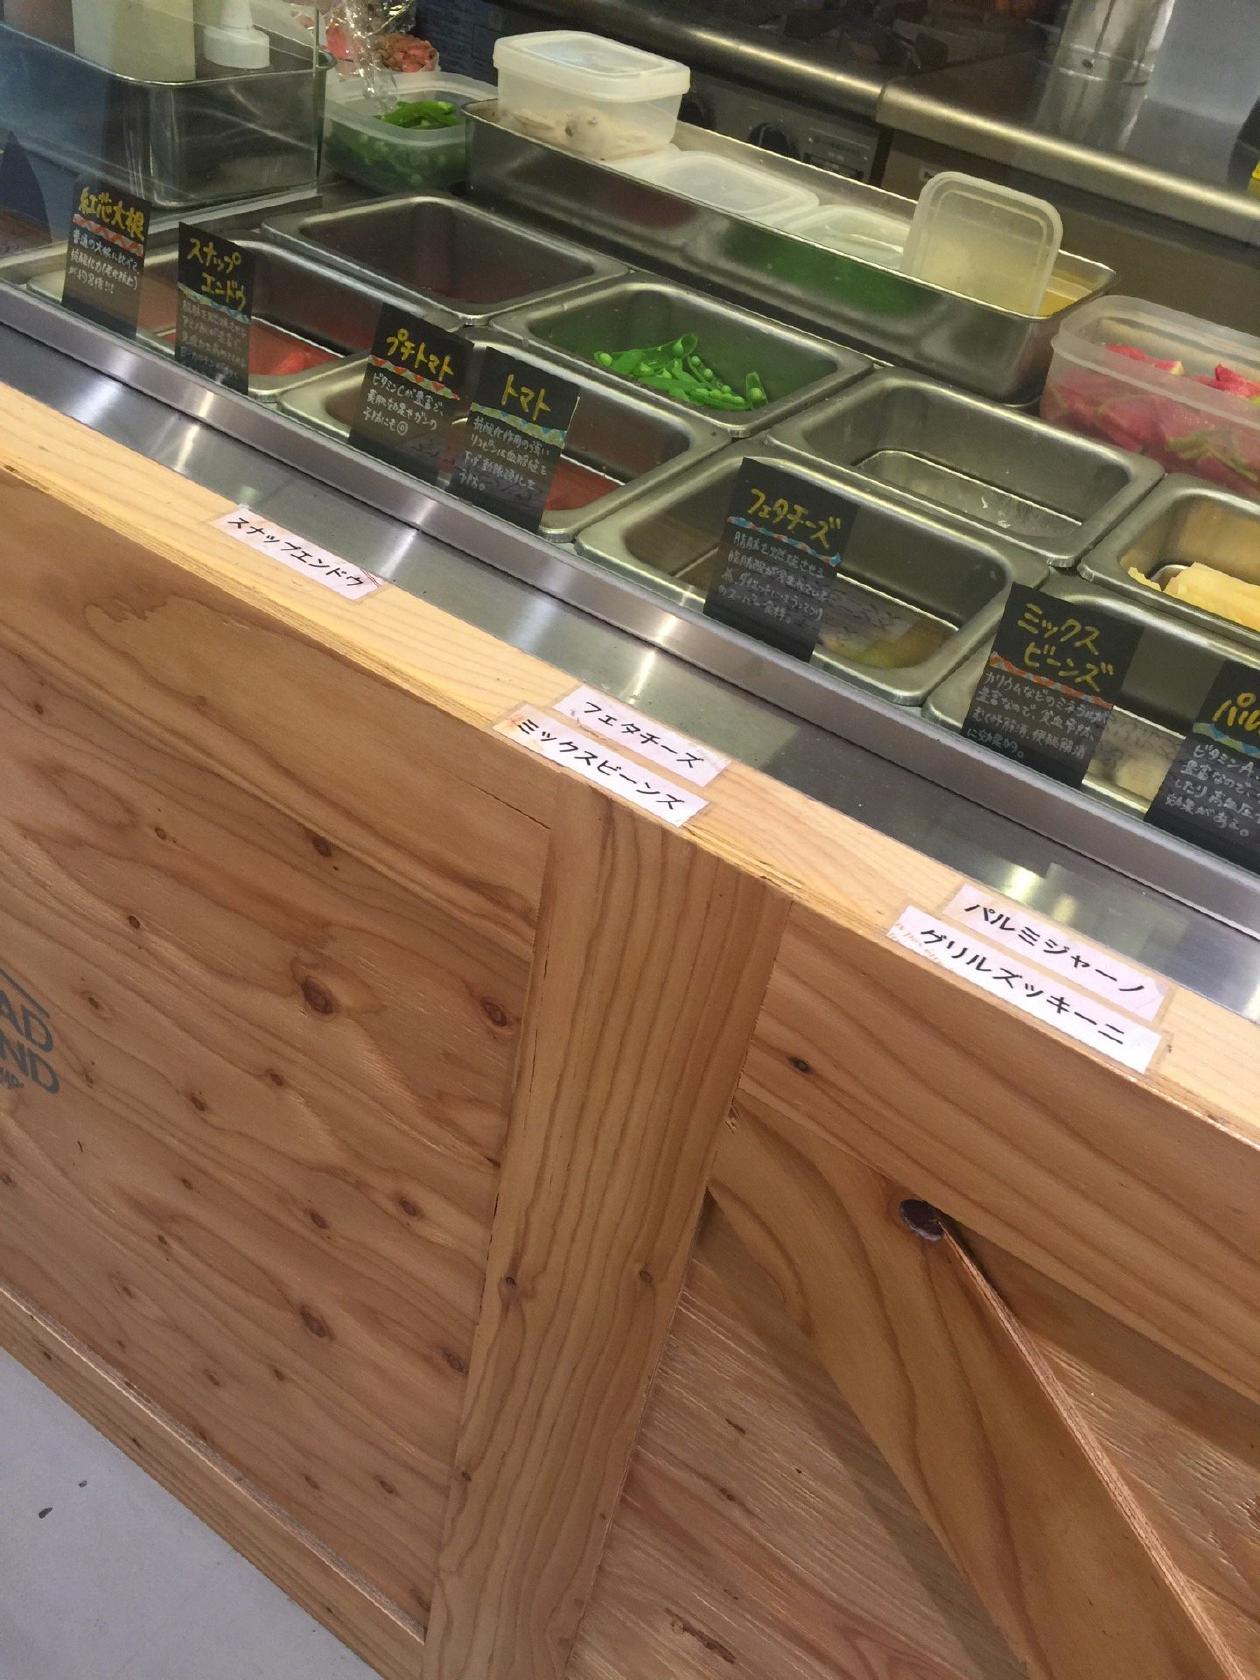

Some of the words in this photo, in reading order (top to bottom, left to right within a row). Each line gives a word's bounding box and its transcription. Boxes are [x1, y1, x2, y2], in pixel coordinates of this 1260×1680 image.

[187, 238, 242, 274] スナップ
[201, 272, 247, 311] エンドウ
[386, 328, 454, 382] プチトマト
[501, 374, 551, 421] トマト
[748, 488, 841, 549] フェタチーズ
[227, 517, 364, 586] スナップエンドウ
[1017, 603, 1100, 656] ミックス
[1023, 642, 1115, 693] ビーンズ
[584, 701, 704, 768] フェタチーズ
[1212, 692, 1260, 737] パル
[518, 719, 685, 810] ミックスビーンズ
[965, 904, 1145, 992] パルミジャーノ
[921, 929, 1125, 1045] グリルズッキーニ
